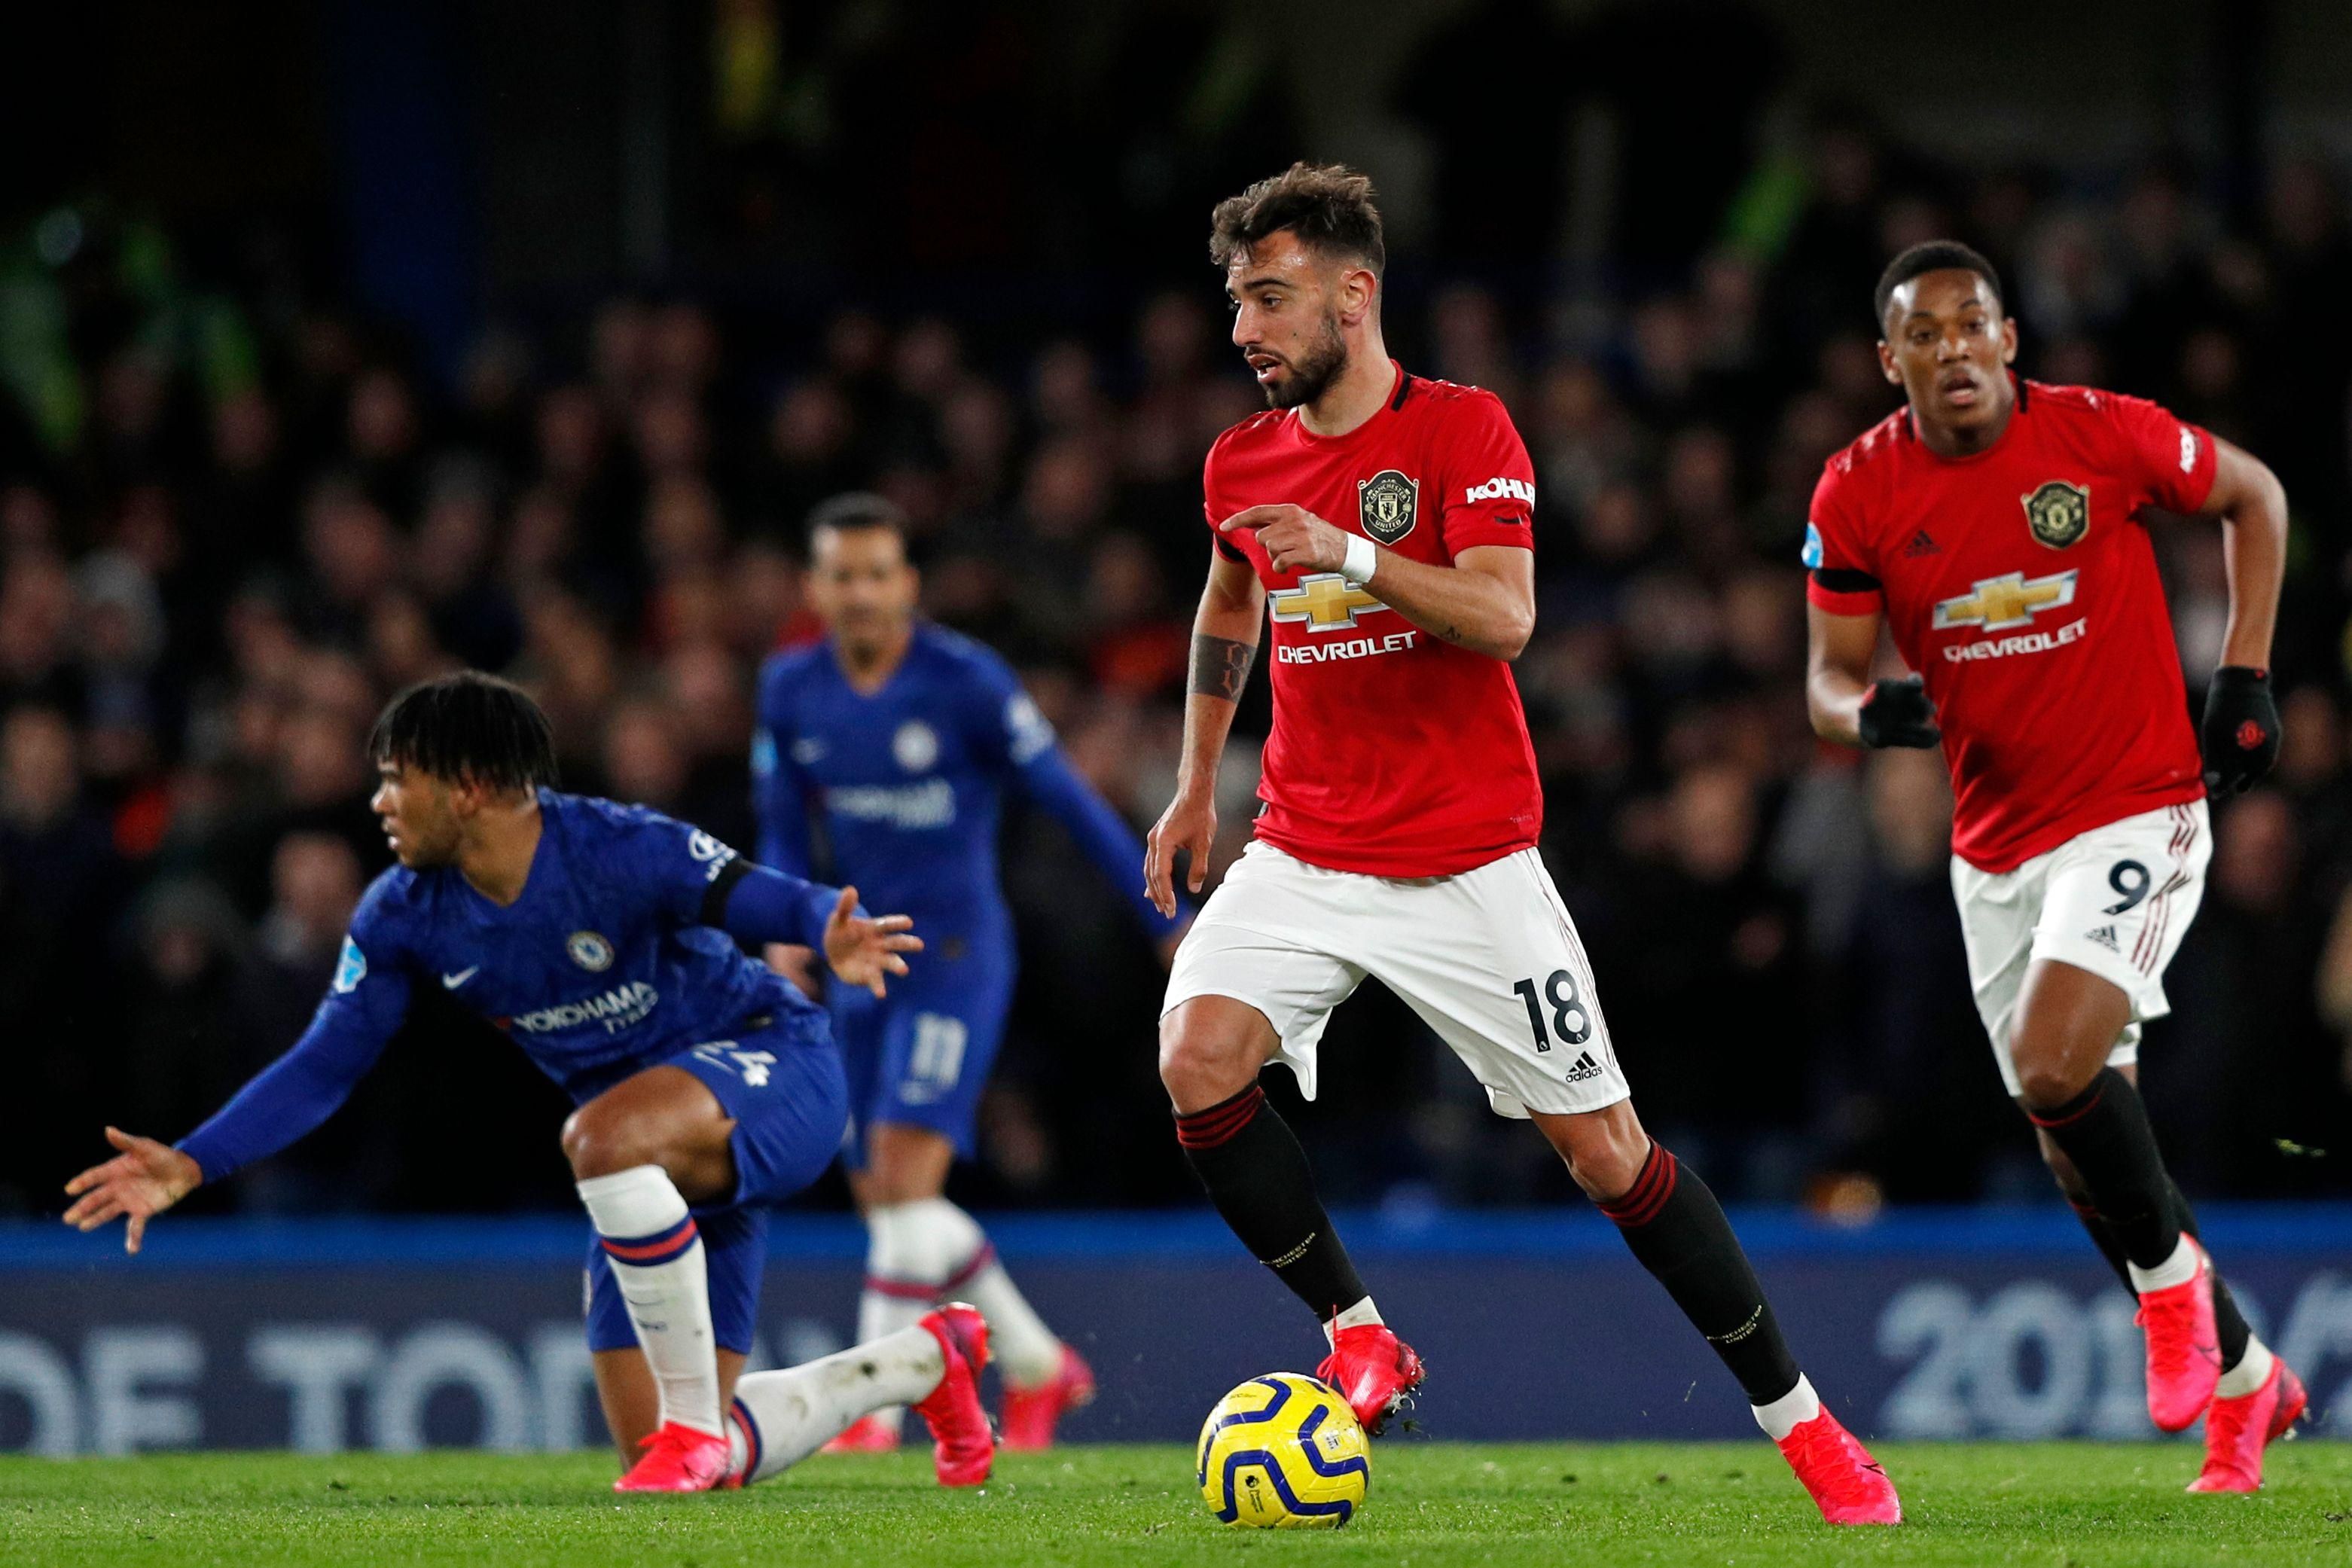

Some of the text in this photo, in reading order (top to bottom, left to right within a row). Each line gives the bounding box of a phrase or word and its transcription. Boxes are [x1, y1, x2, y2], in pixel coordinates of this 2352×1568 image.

[1370, 482, 1408, 501] MANCHESTER
[1374, 519, 1402, 529] UNITED
[1277, 630, 1417, 664] CHEVROLET
[1942, 615, 2088, 664] CHEVROLET
[2100, 859, 2151, 916] 9
[513, 981, 659, 1033] YOKOHAMA
[1513, 969, 1592, 1054] 18
[1566, 1066, 1603, 1083] adidas
[1259, 1231, 1316, 1264] NCHESTER
[1706, 1304, 1762, 1341] NCHESTER
